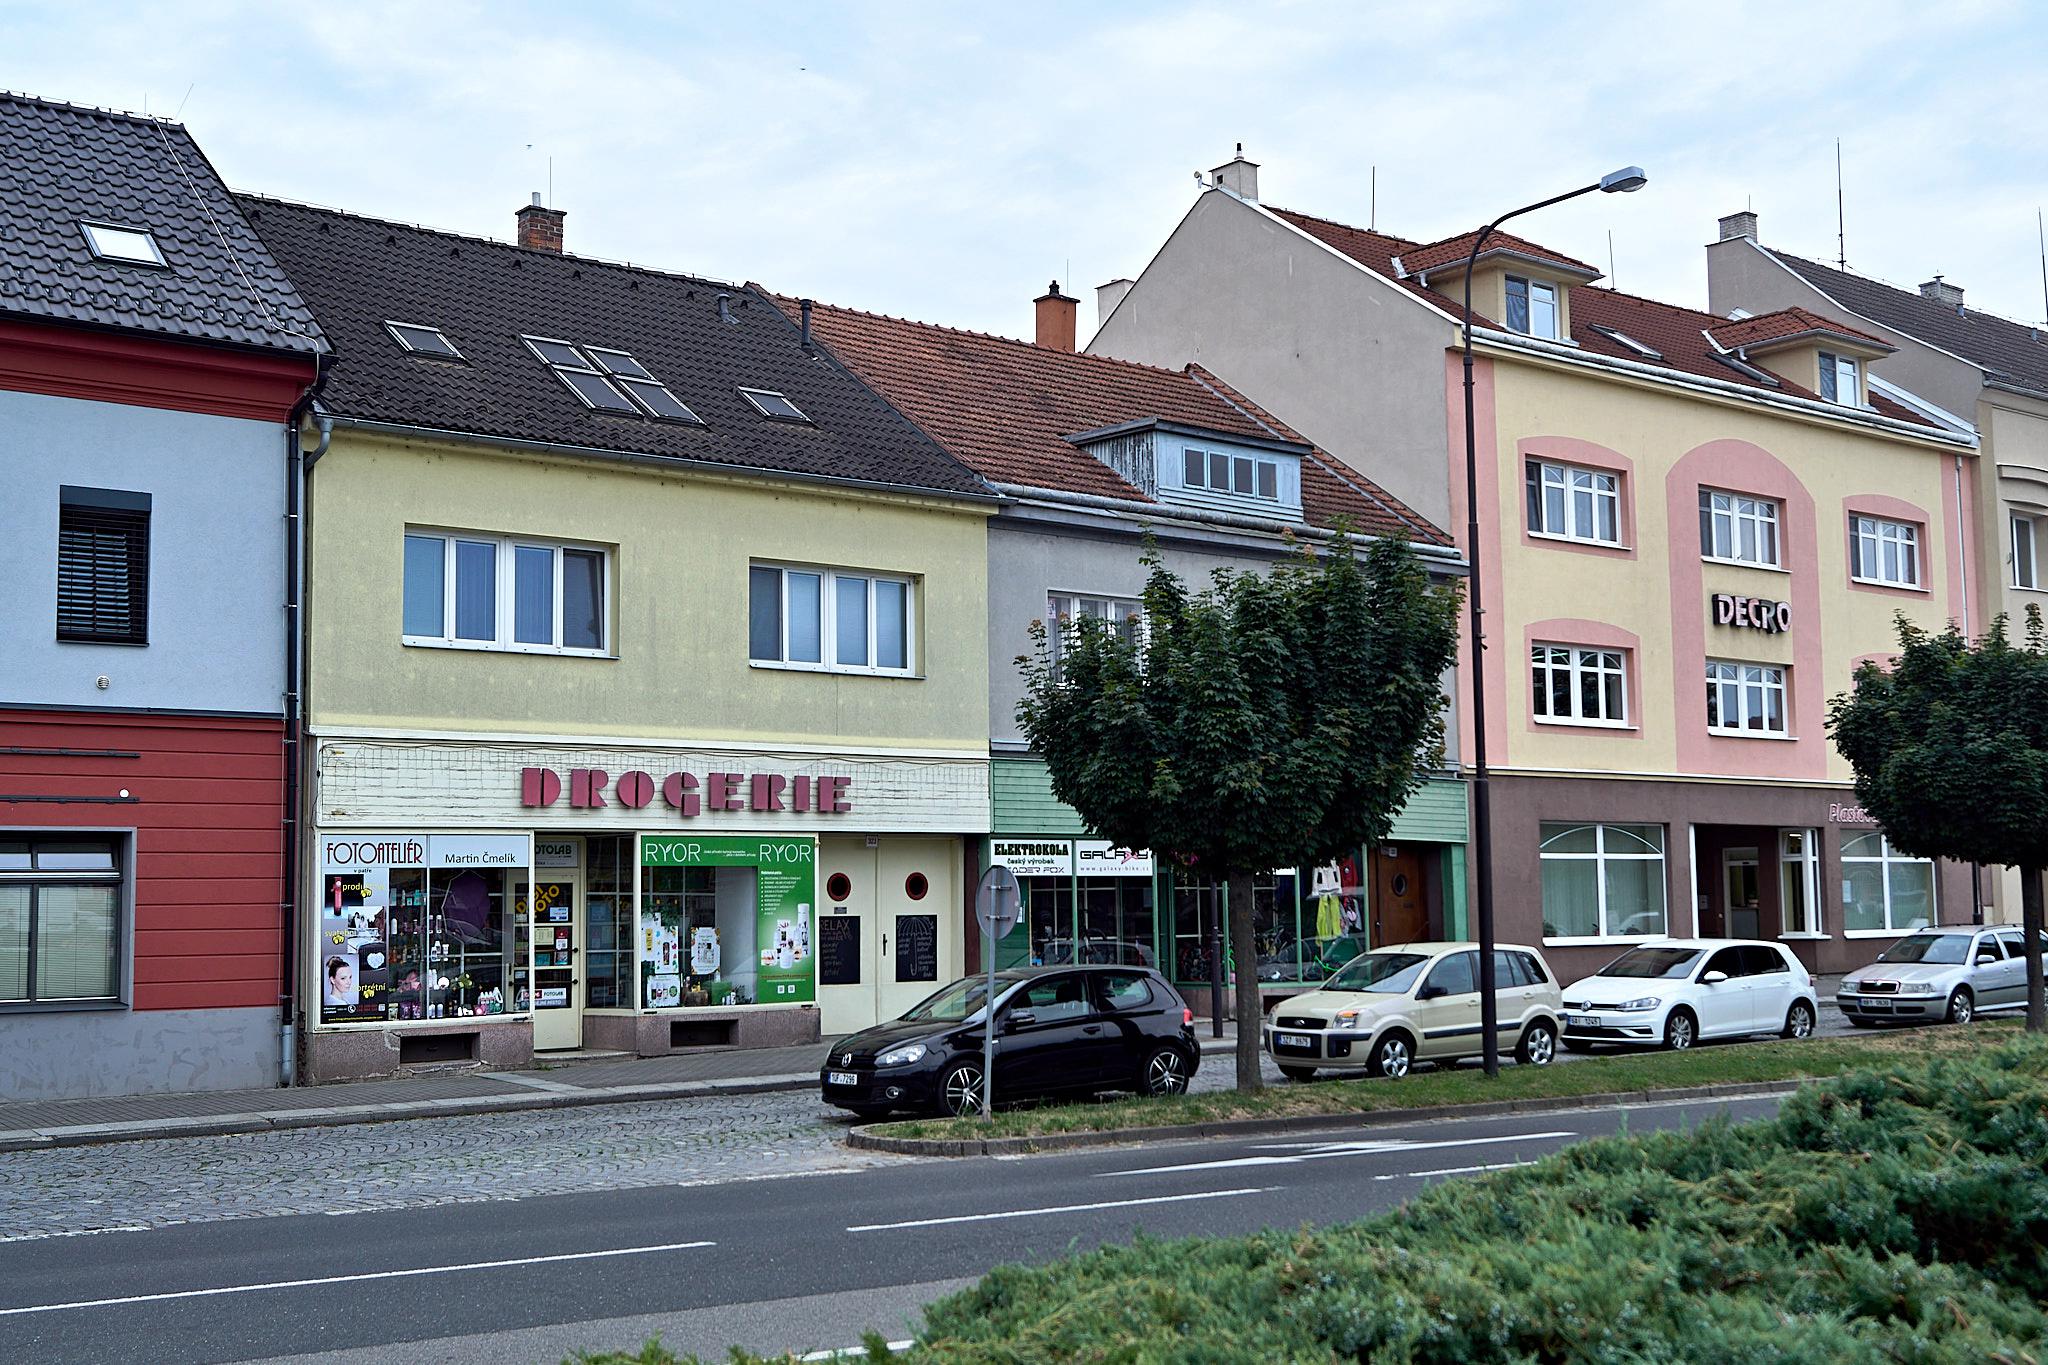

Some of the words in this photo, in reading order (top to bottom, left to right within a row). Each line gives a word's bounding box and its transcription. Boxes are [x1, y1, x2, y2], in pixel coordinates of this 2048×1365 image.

[1712, 593, 1792, 634] DECRO
[522, 768, 851, 817] DROGERIE
[326, 838, 423, 865] FOTOATELIÉR
[445, 853, 480, 864] Martin
[482, 851, 516, 864] Čmelík
[645, 843, 701, 863] RYOR
[759, 843, 811, 863] RYOR
[994, 843, 1069, 856] ELEKTROKOLA
[1007, 858, 1026, 866] český
[1028, 857, 1055, 866] výrobek
[1043, 866, 1065, 874] FOX
